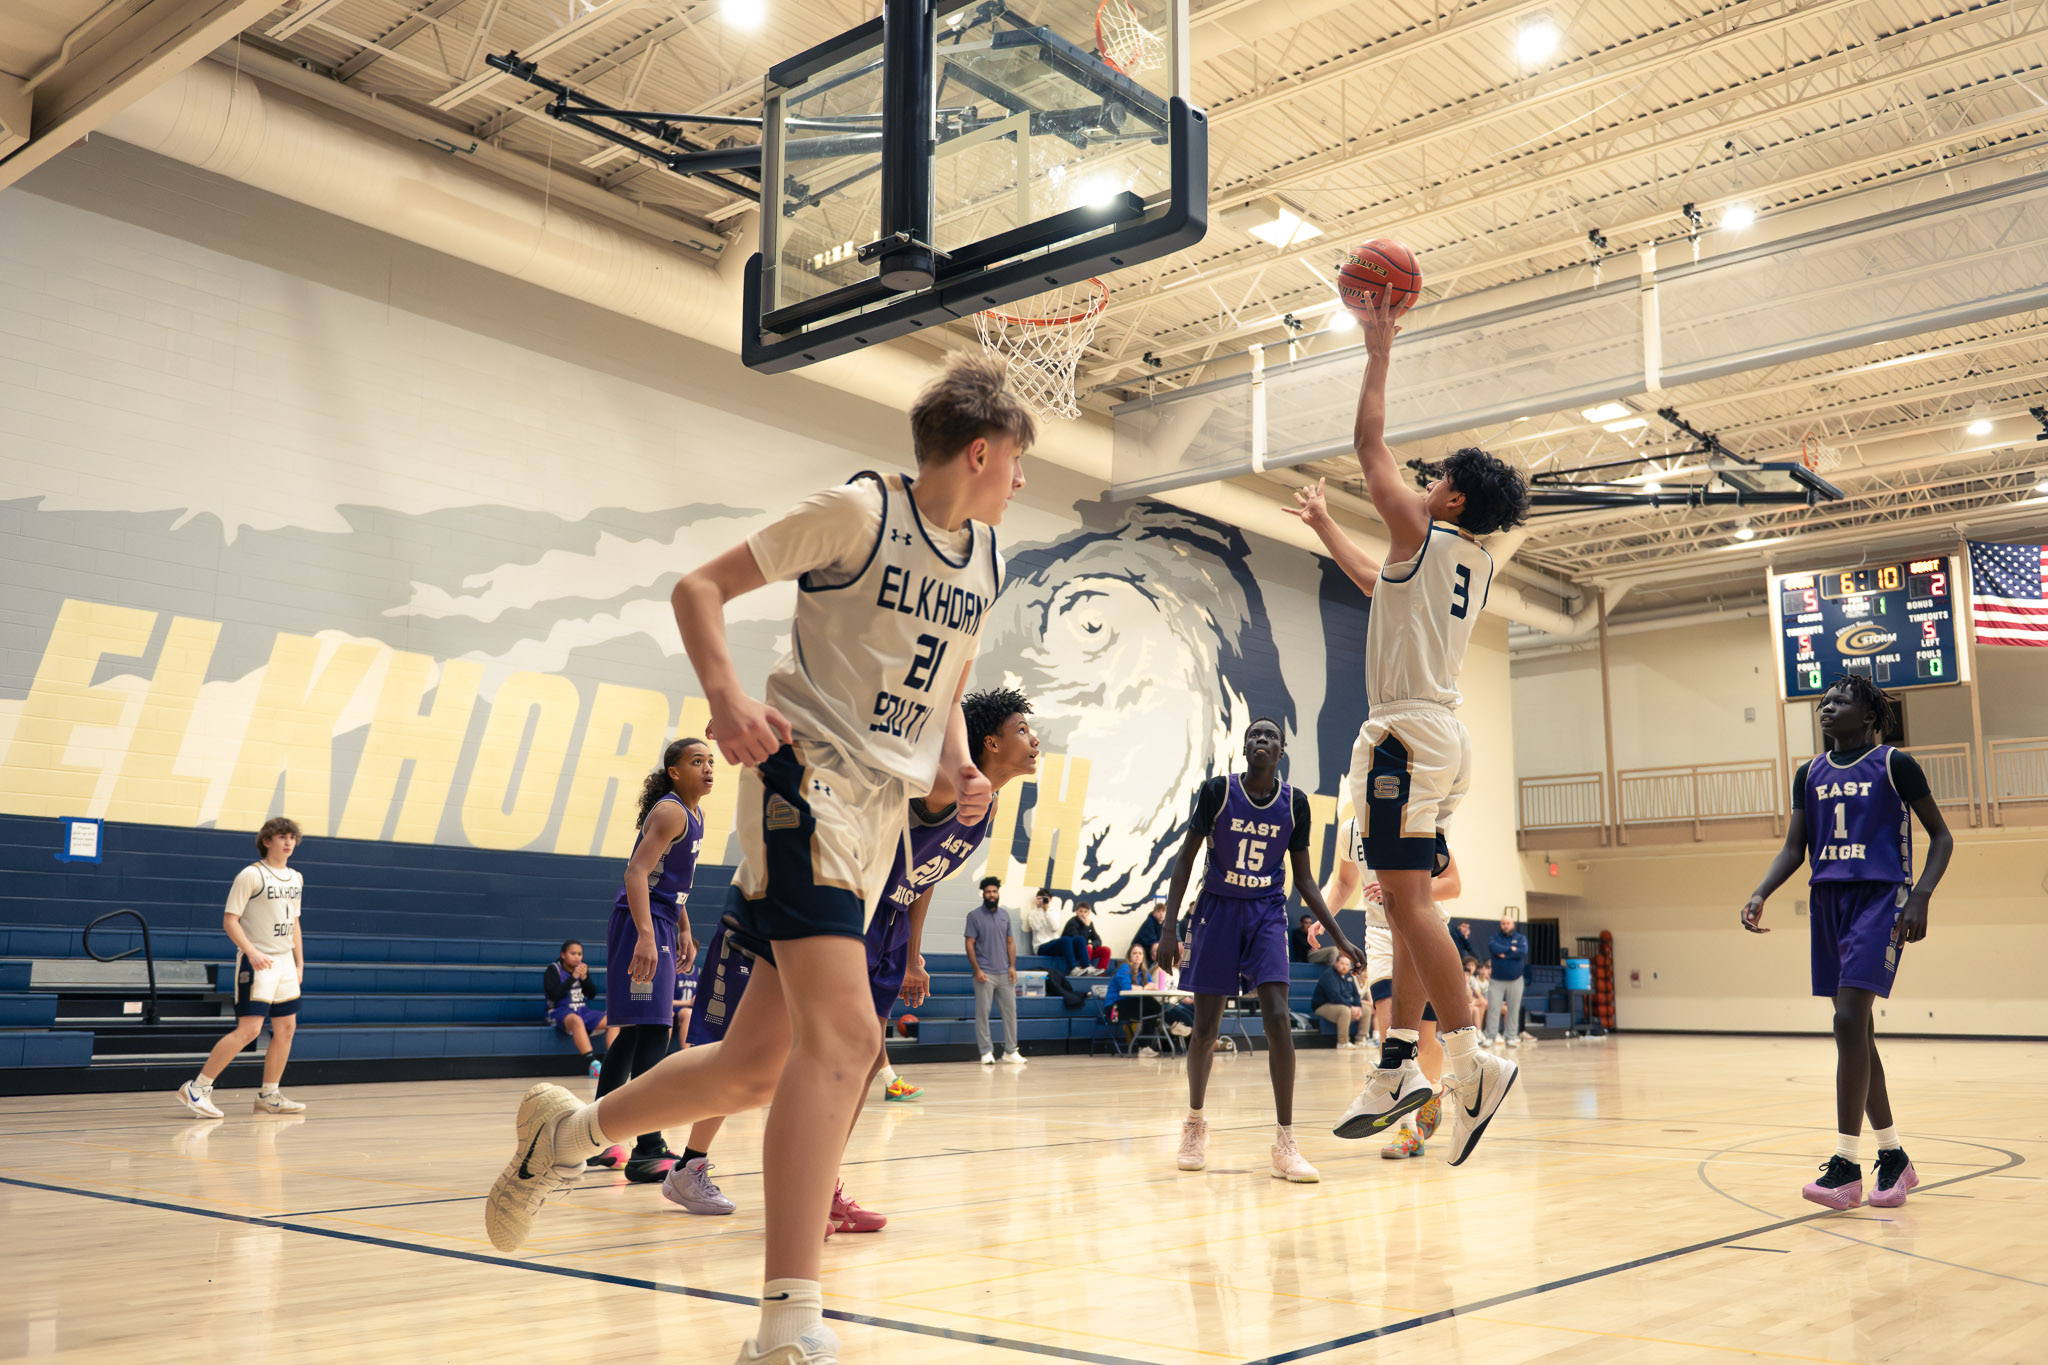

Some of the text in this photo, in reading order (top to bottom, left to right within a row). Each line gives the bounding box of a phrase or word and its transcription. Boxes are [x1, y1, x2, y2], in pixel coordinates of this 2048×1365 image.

[1840, 566, 1899, 594] 6:10
[1930, 573, 1945, 596] 2
[877, 564, 988, 637] ELKHORN
[1450, 563, 1471, 620] 3
[1802, 588, 1818, 612] 5
[1880, 597, 1886, 614] 1
[1906, 599, 1933, 610] BONUS
[1797, 612, 1823, 624] BONUS
[1908, 610, 1949, 623] TIMEOUTS
[1786, 625, 1824, 638] TIMEOUTS
[1863, 632, 1897, 645] STORM
[1923, 620, 1937, 639] 5
[1798, 635, 1812, 653] 5
[1920, 638, 1940, 648] LEFT
[902, 633, 949, 693] 21
[1796, 651, 1815, 662] LEFT
[1842, 653, 1901, 668] PLAYER FOULS
[1916, 649, 1942, 660] FOULS
[1796, 661, 1821, 672] FOULS
[1929, 658, 1943, 677] 0
[1808, 670, 1822, 689] 0
[1815, 781, 1873, 801] EAST
[1230, 817, 1281, 838] EAST
[1833, 802, 1848, 839] 1
[1235, 838, 1268, 872] 15
[1224, 870, 1272, 888] HIGH
[285, 904, 290, 920] 1
[678, 980, 698, 988] EAST
